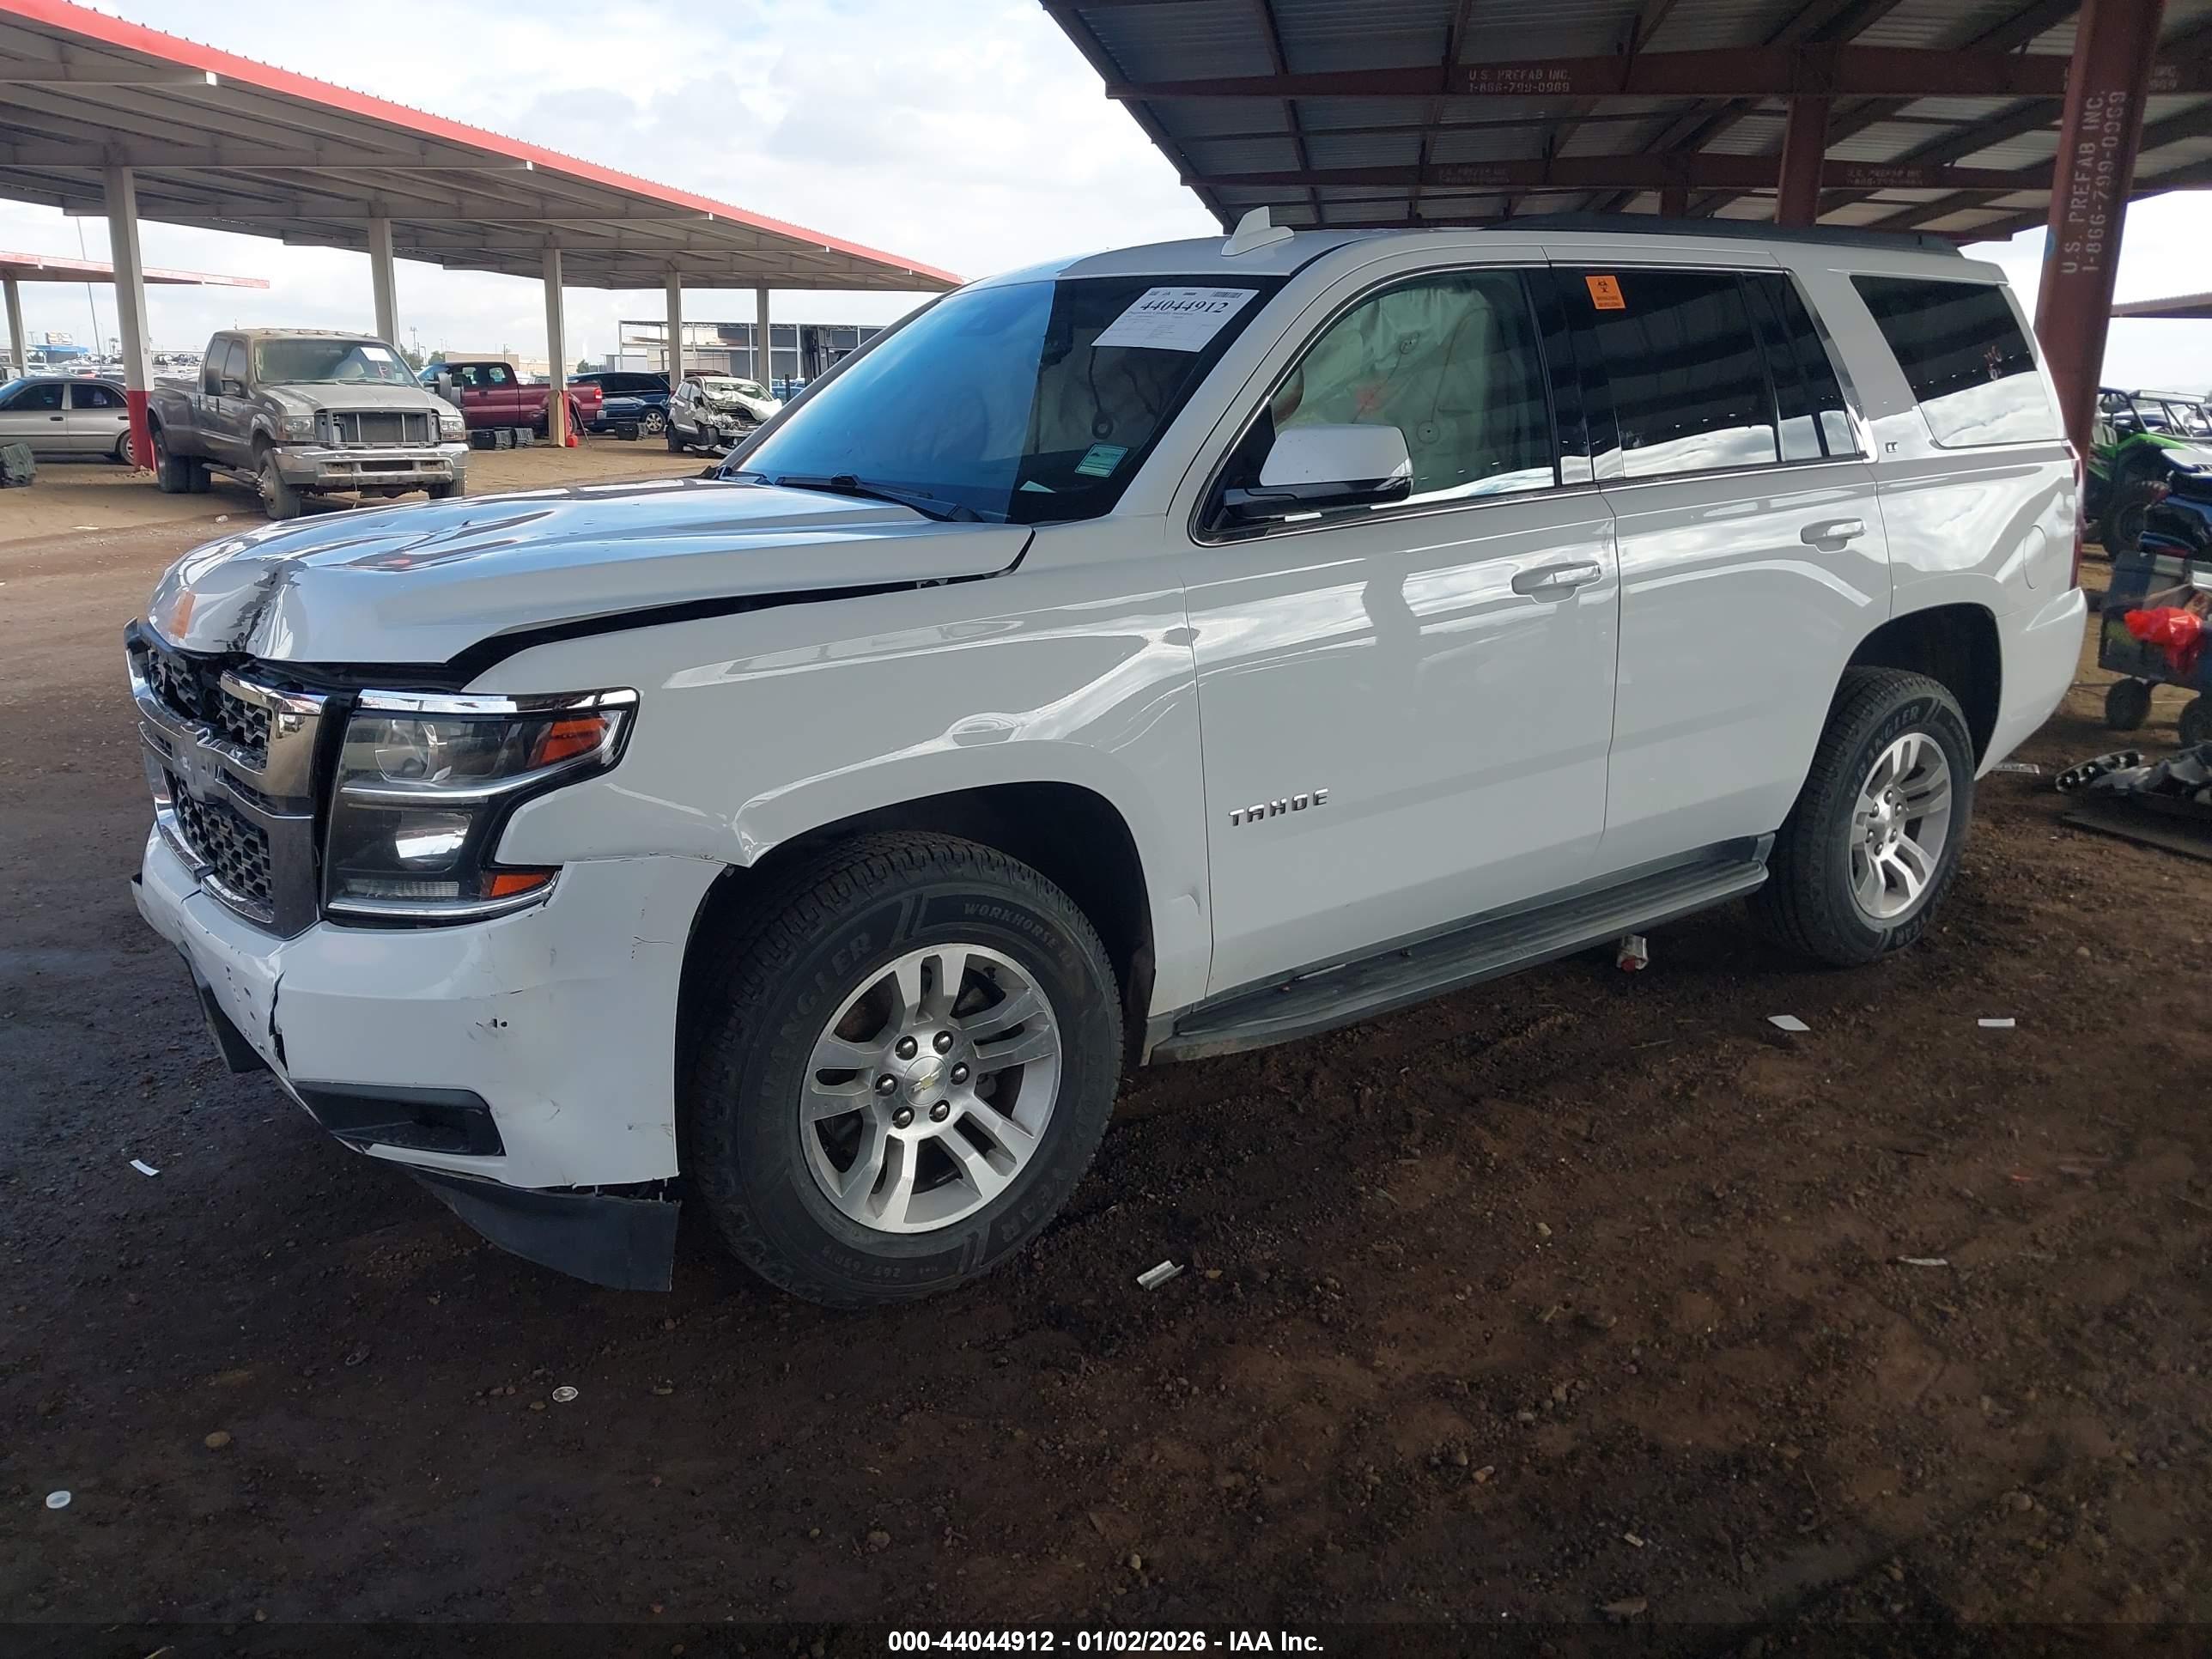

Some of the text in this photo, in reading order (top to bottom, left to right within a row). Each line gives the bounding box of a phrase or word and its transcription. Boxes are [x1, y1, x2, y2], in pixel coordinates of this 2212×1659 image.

[1497, 68, 1544, 81] PREFAB
[2061, 90, 2106, 274] U.S. PREFAB INC.
[1139, 300, 1229, 313] 44044912
[1228, 787, 1329, 827] TAHOE
[963, 902, 1060, 949] WORKHORSE
